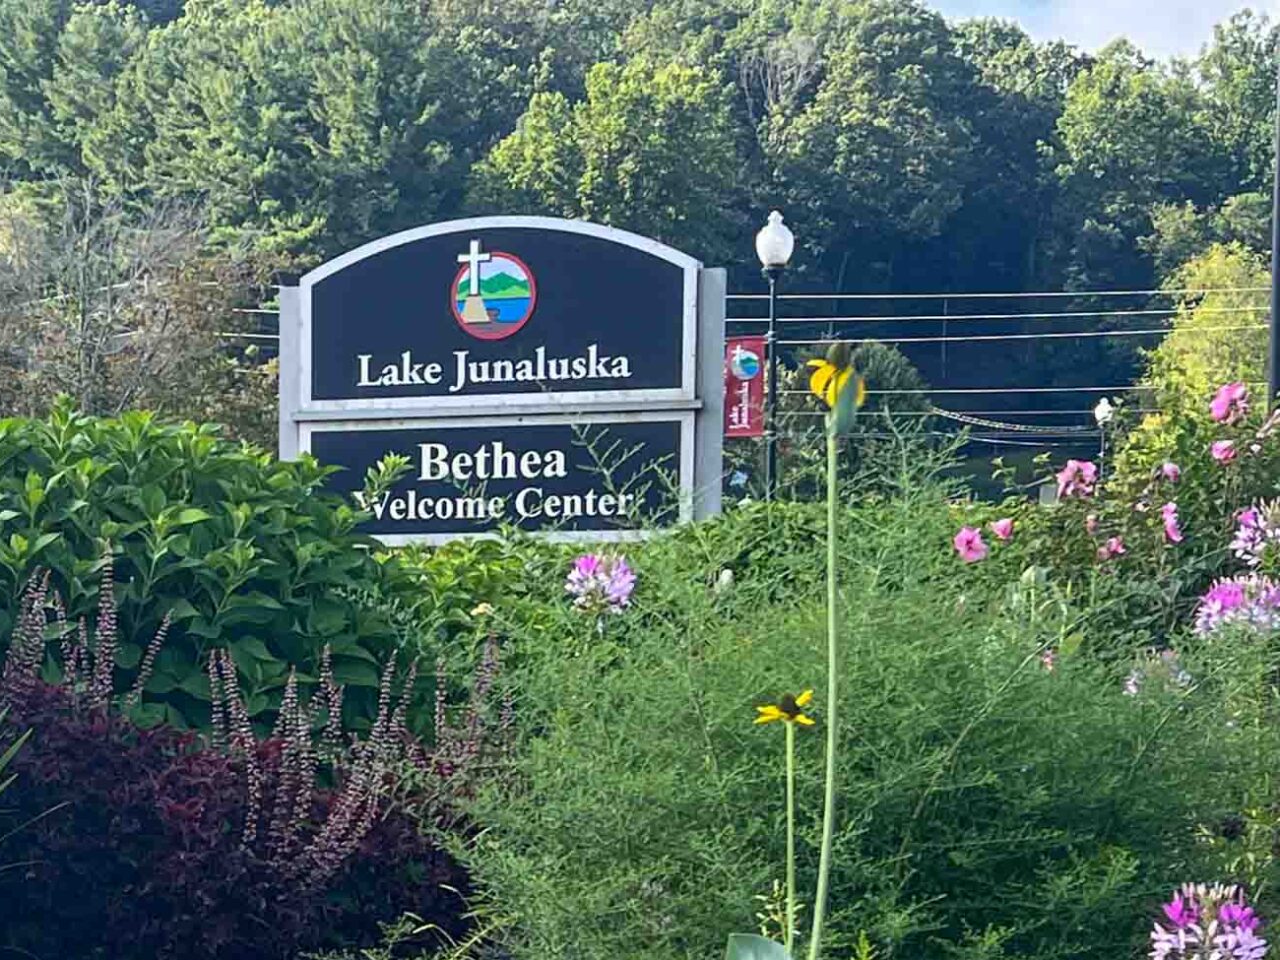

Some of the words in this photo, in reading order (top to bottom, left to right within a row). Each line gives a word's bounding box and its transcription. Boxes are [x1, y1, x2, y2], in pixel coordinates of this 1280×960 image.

[357, 351, 442, 387] Lake
[449, 344, 632, 392] Junaluska
[417, 441, 568, 482] Bethea
[353, 490, 506, 522] Welcome
[515, 487, 634, 518] Center
